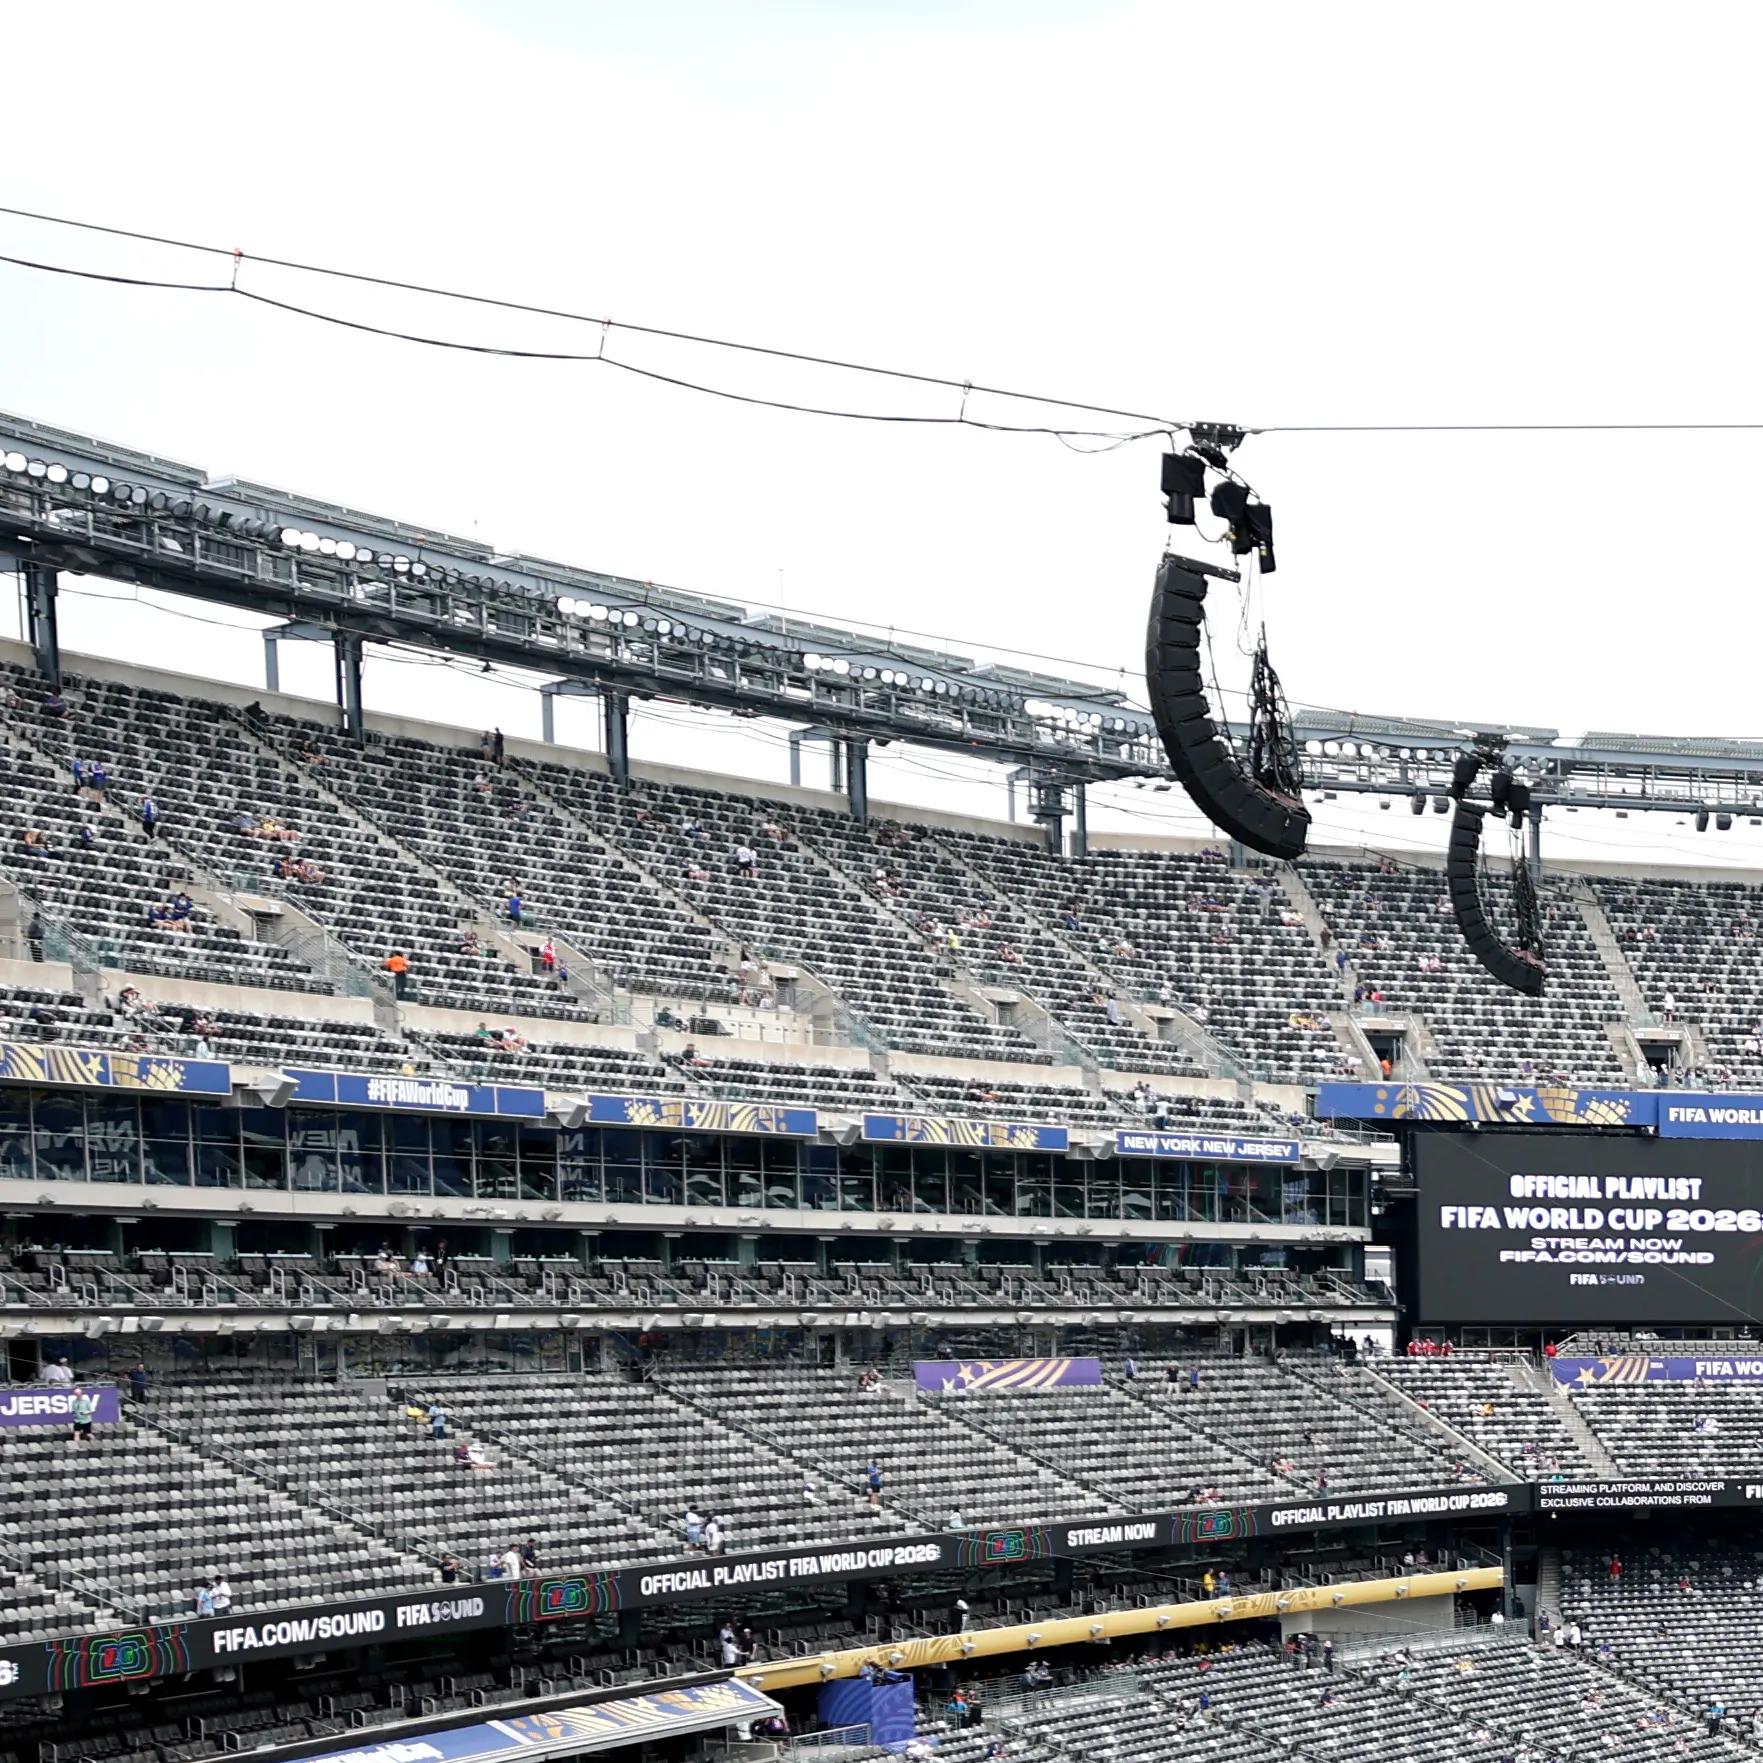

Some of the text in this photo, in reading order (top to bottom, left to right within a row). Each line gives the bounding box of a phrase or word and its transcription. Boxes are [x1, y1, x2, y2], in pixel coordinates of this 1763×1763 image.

[368, 1078, 468, 1110] #FIFAWorldCup
[1669, 1108, 1707, 1123] FIFA
[1124, 1136, 1291, 1156] NEW YORK NEW JERSEY
[1509, 1175, 1702, 1200] OFFICIAL PLAYLIST
[1441, 1206, 1501, 1229] FIFA
[1503, 1207, 1603, 1230] WORLD
[1607, 1208, 1663, 1231] CUP
[1531, 1237, 1682, 1250] STREAM NOW
[1500, 1251, 1714, 1263] FIFA.COM/SOUND
[1695, 1361, 1739, 1375] FIFA
[1541, 1480, 1725, 1494] STREAMING PLATFORM, AND DISCOVER
[1271, 1505, 1326, 1527] OFFICIAL
[1327, 1500, 1385, 1522] PLAYLIST
[1388, 1498, 1411, 1518] FIFA
[1411, 1496, 1447, 1516] WORLD
[1448, 1494, 1470, 1513] CUP
[1541, 1494, 1712, 1507] EXCLUSIVE COLLABORATIONS FROM
[1067, 1522, 1156, 1547] STREAM NOW
[641, 1569, 711, 1596] OFFICIAL
[713, 1561, 787, 1588] PLAYLIST
[790, 1557, 819, 1579] FIFA
[820, 1552, 867, 1576] WORLD
[868, 1549, 894, 1570] CUP
[213, 1610, 384, 1654] FIFA.COM/SOUND
